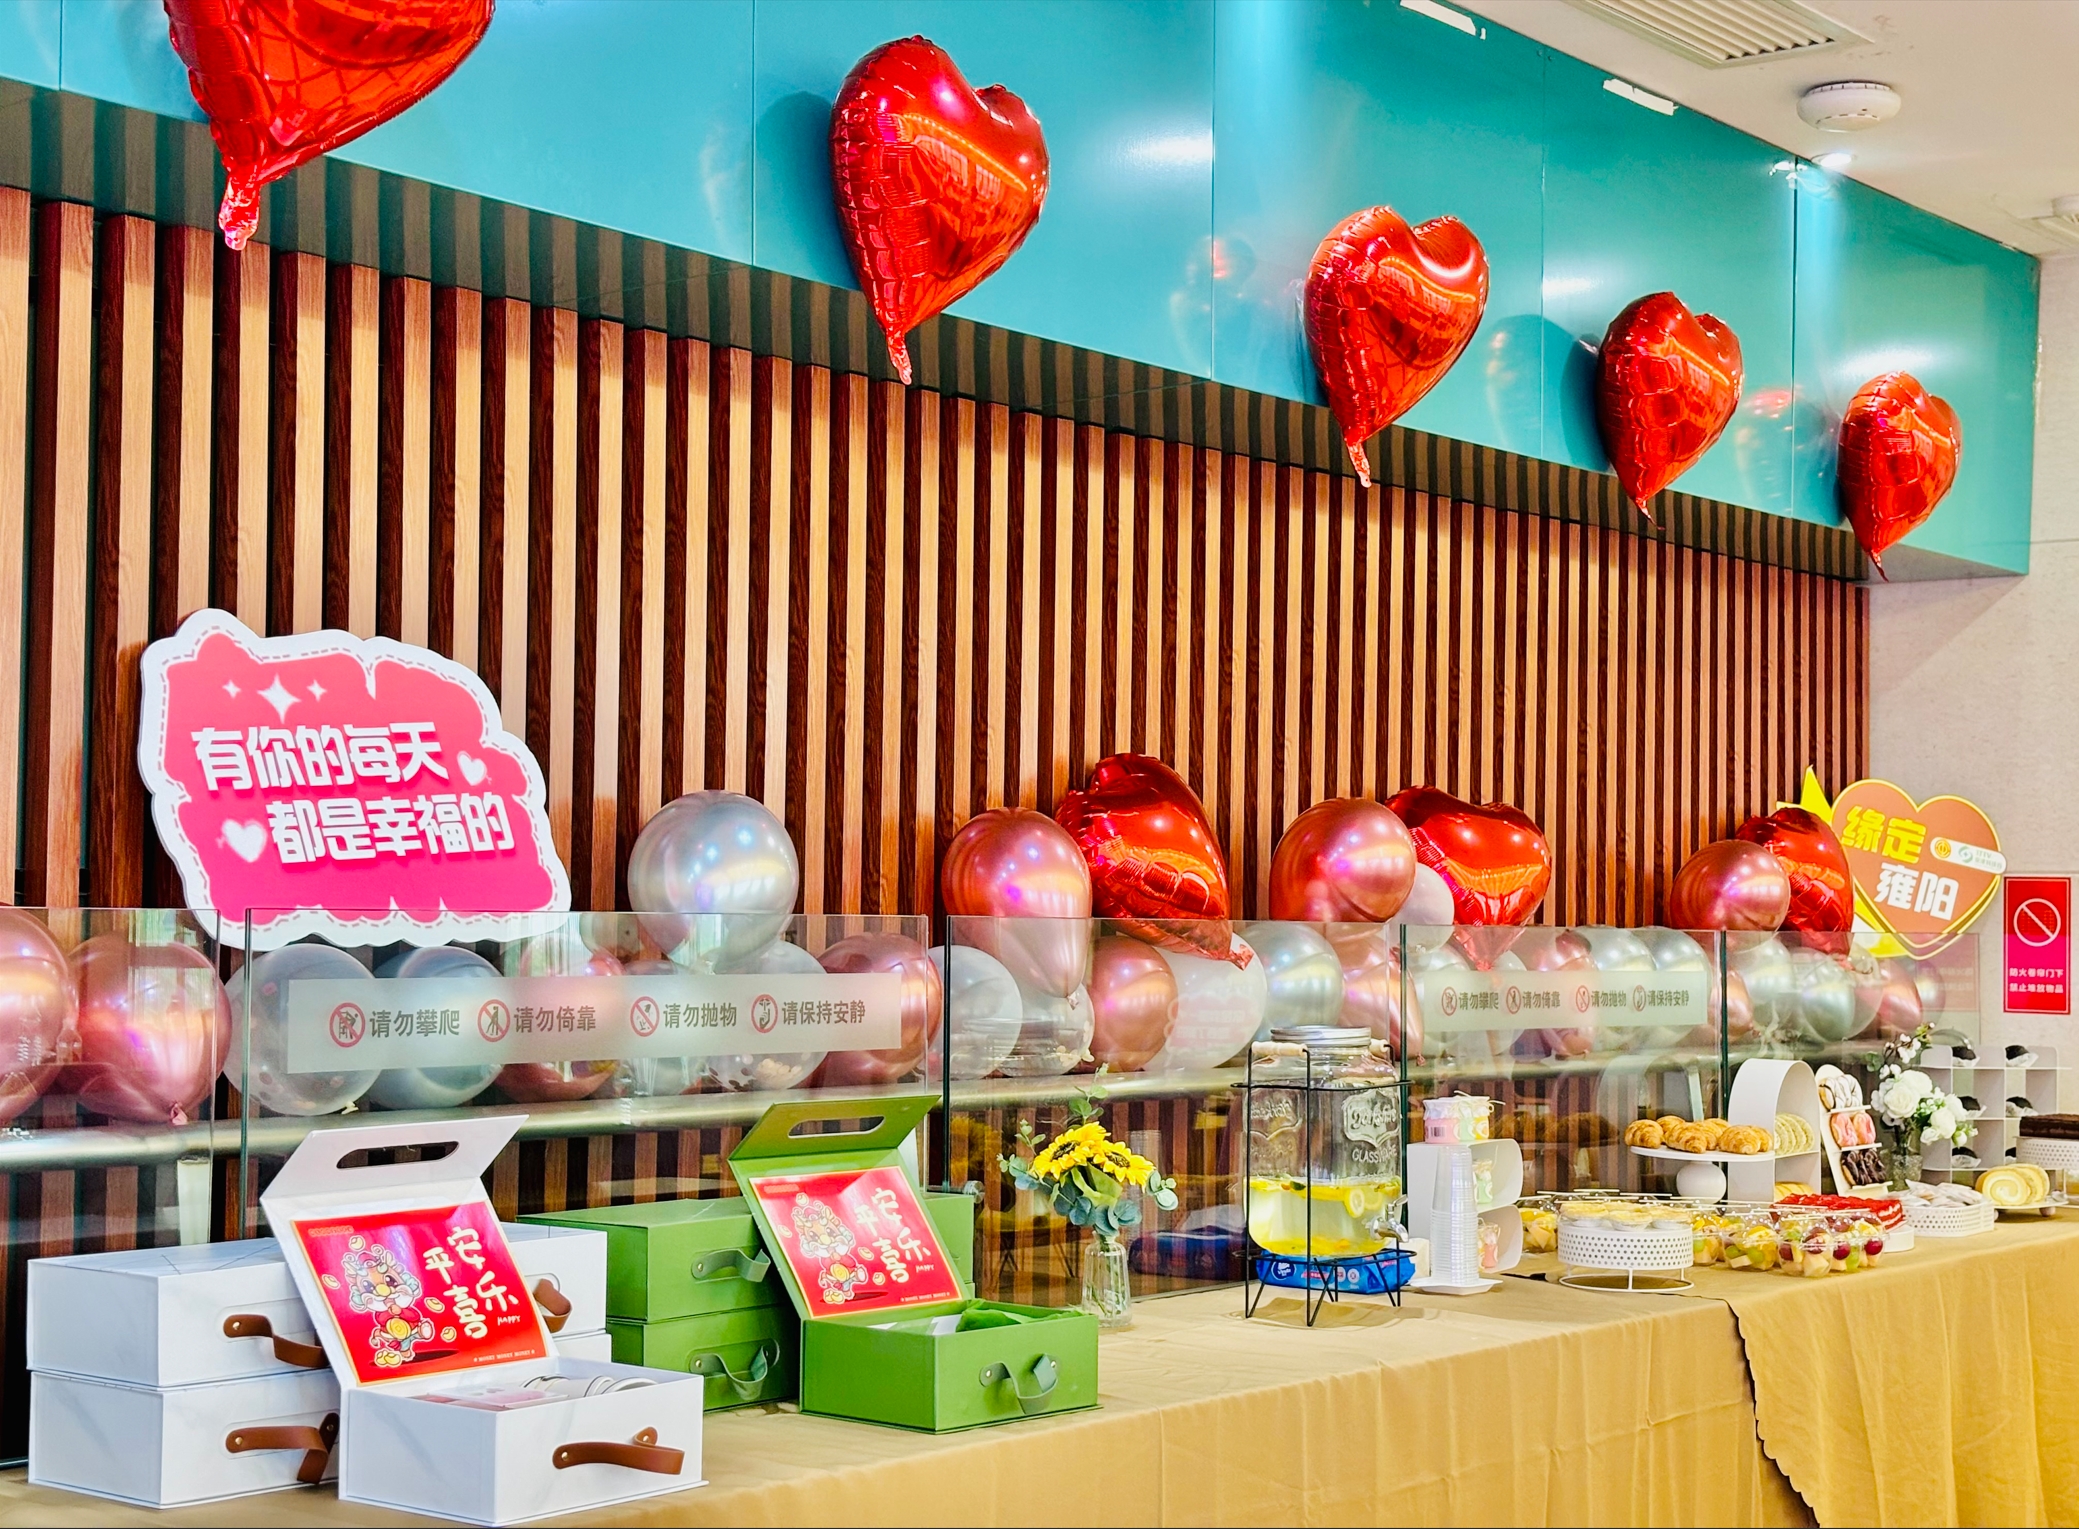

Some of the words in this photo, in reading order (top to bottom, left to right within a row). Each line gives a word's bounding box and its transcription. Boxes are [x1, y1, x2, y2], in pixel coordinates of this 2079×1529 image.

[191, 721, 449, 792] 有你的每天
[267, 792, 515, 865] 都是幸福的
[1840, 805, 1927, 864] 缘定
[1874, 862, 1959, 921] 雍阳
[369, 1009, 460, 1038] 请勿攀爬
[513, 1005, 596, 1033] 请勿倚靠
[663, 1002, 737, 1029] 请勿抛物
[781, 1000, 866, 1026] 请保持安静
[1458, 991, 1499, 1011] 请勿攀爬
[1522, 990, 1561, 1009] 请勿倚靠
[1591, 989, 1627, 1007] 请勿抛物
[1647, 988, 1689, 1007] 请保持安静
[497, 1314, 521, 1326] HAPPY
